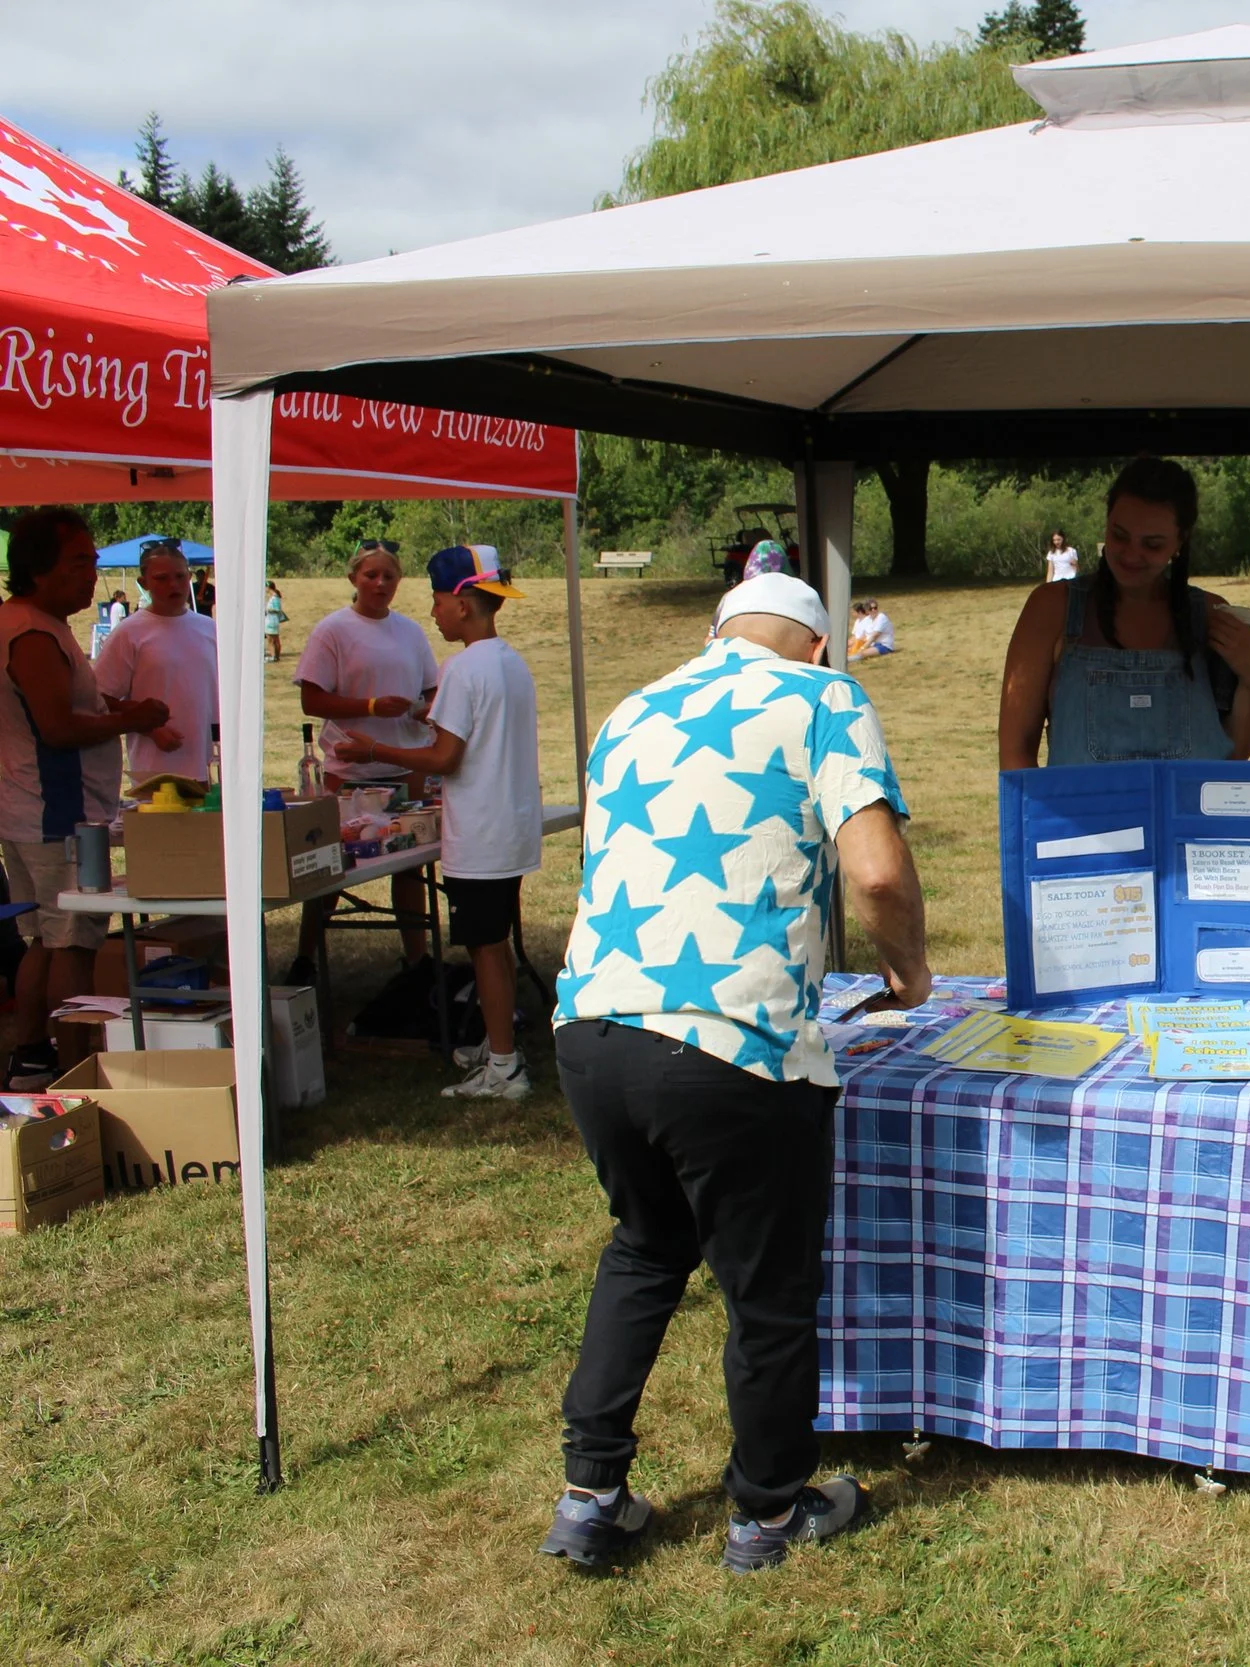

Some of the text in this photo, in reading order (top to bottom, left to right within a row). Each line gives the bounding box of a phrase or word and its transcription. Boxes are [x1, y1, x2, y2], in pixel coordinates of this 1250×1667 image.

[0, 326, 149, 428] Rising
[163, 345, 210, 410] Ti
[1199, 850, 1225, 858] BOOK
[1047, 890, 1107, 902] SALE TODAY
[1183, 1046, 1247, 1056] School
